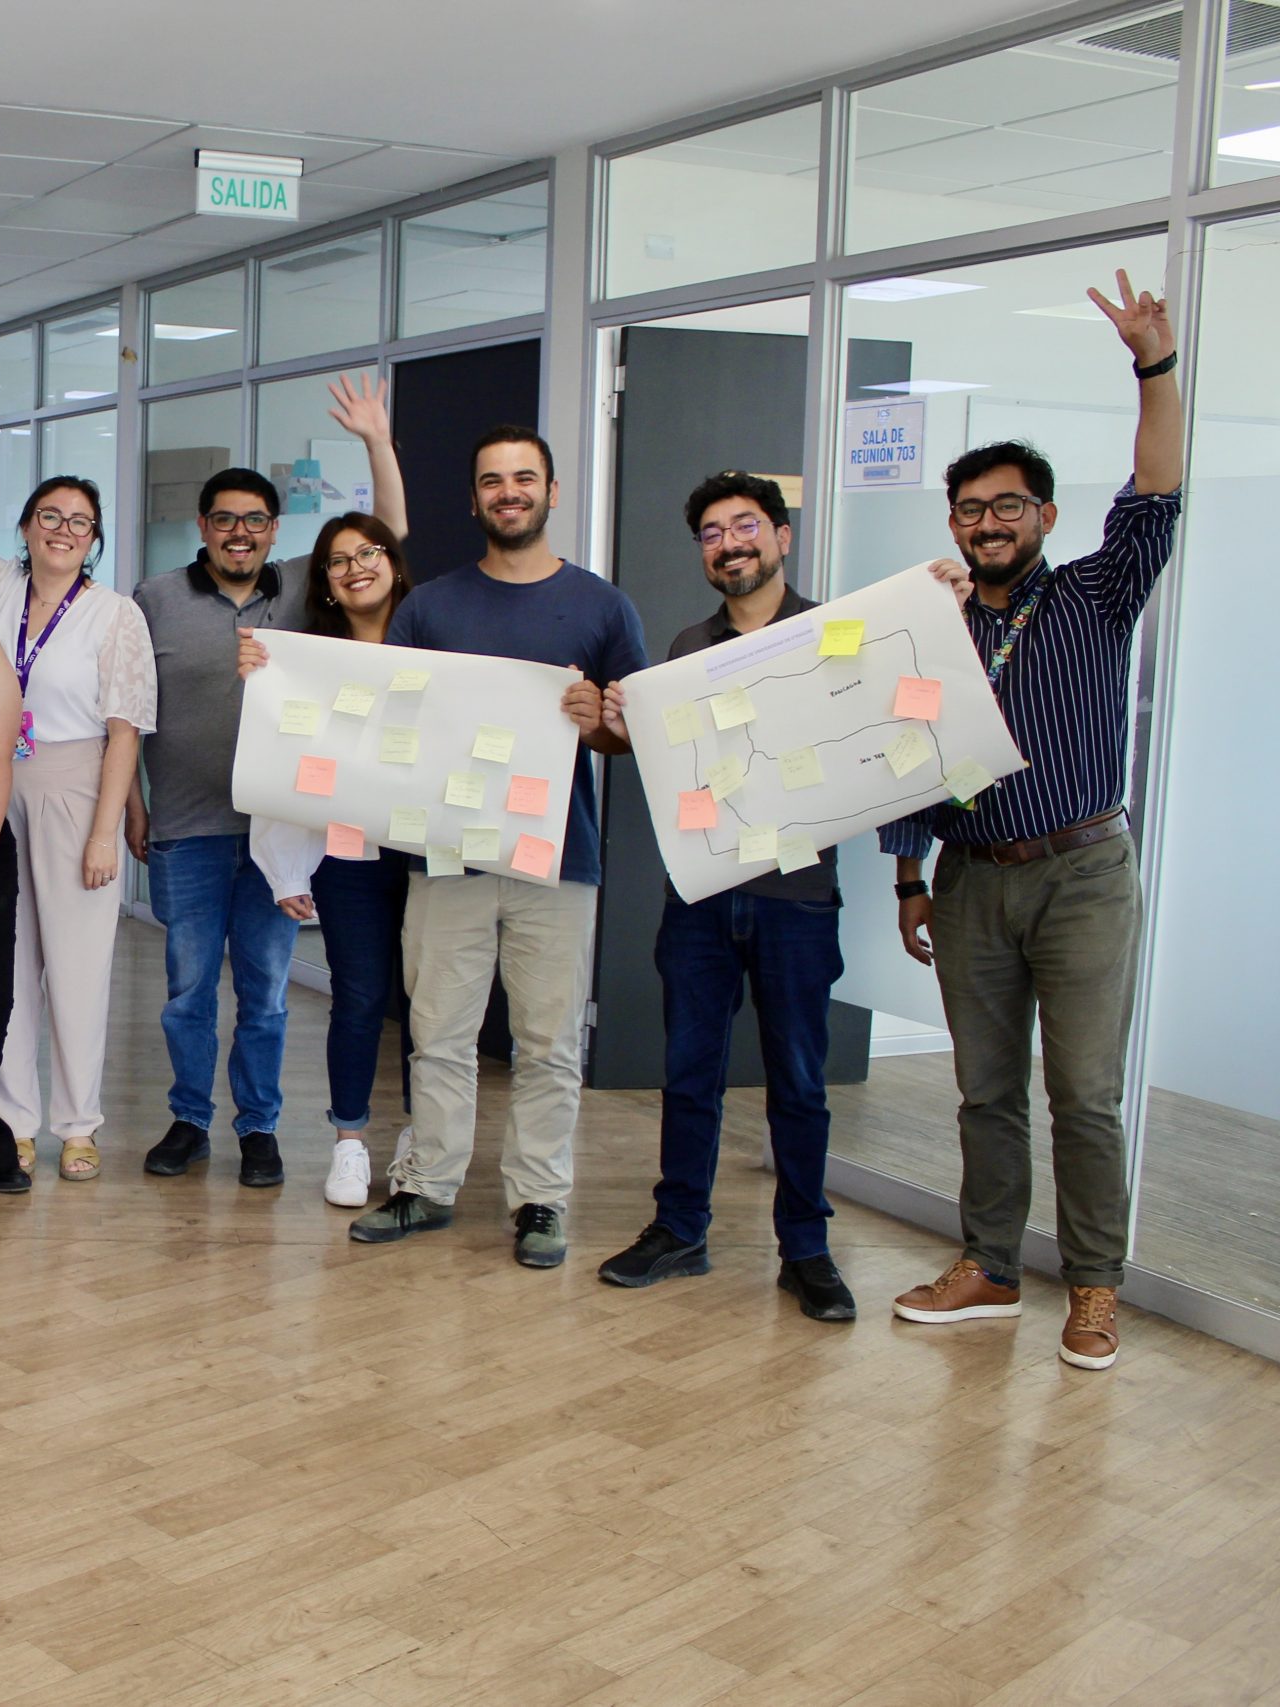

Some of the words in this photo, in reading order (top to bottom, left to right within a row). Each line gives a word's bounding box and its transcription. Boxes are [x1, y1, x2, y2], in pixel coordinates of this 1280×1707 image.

[210, 176, 287, 210] SALIDA
[862, 429, 888, 445] SALA
[891, 427, 904, 443] DE
[850, 444, 894, 464] REUNIÓN
[896, 445, 916, 462] 703
